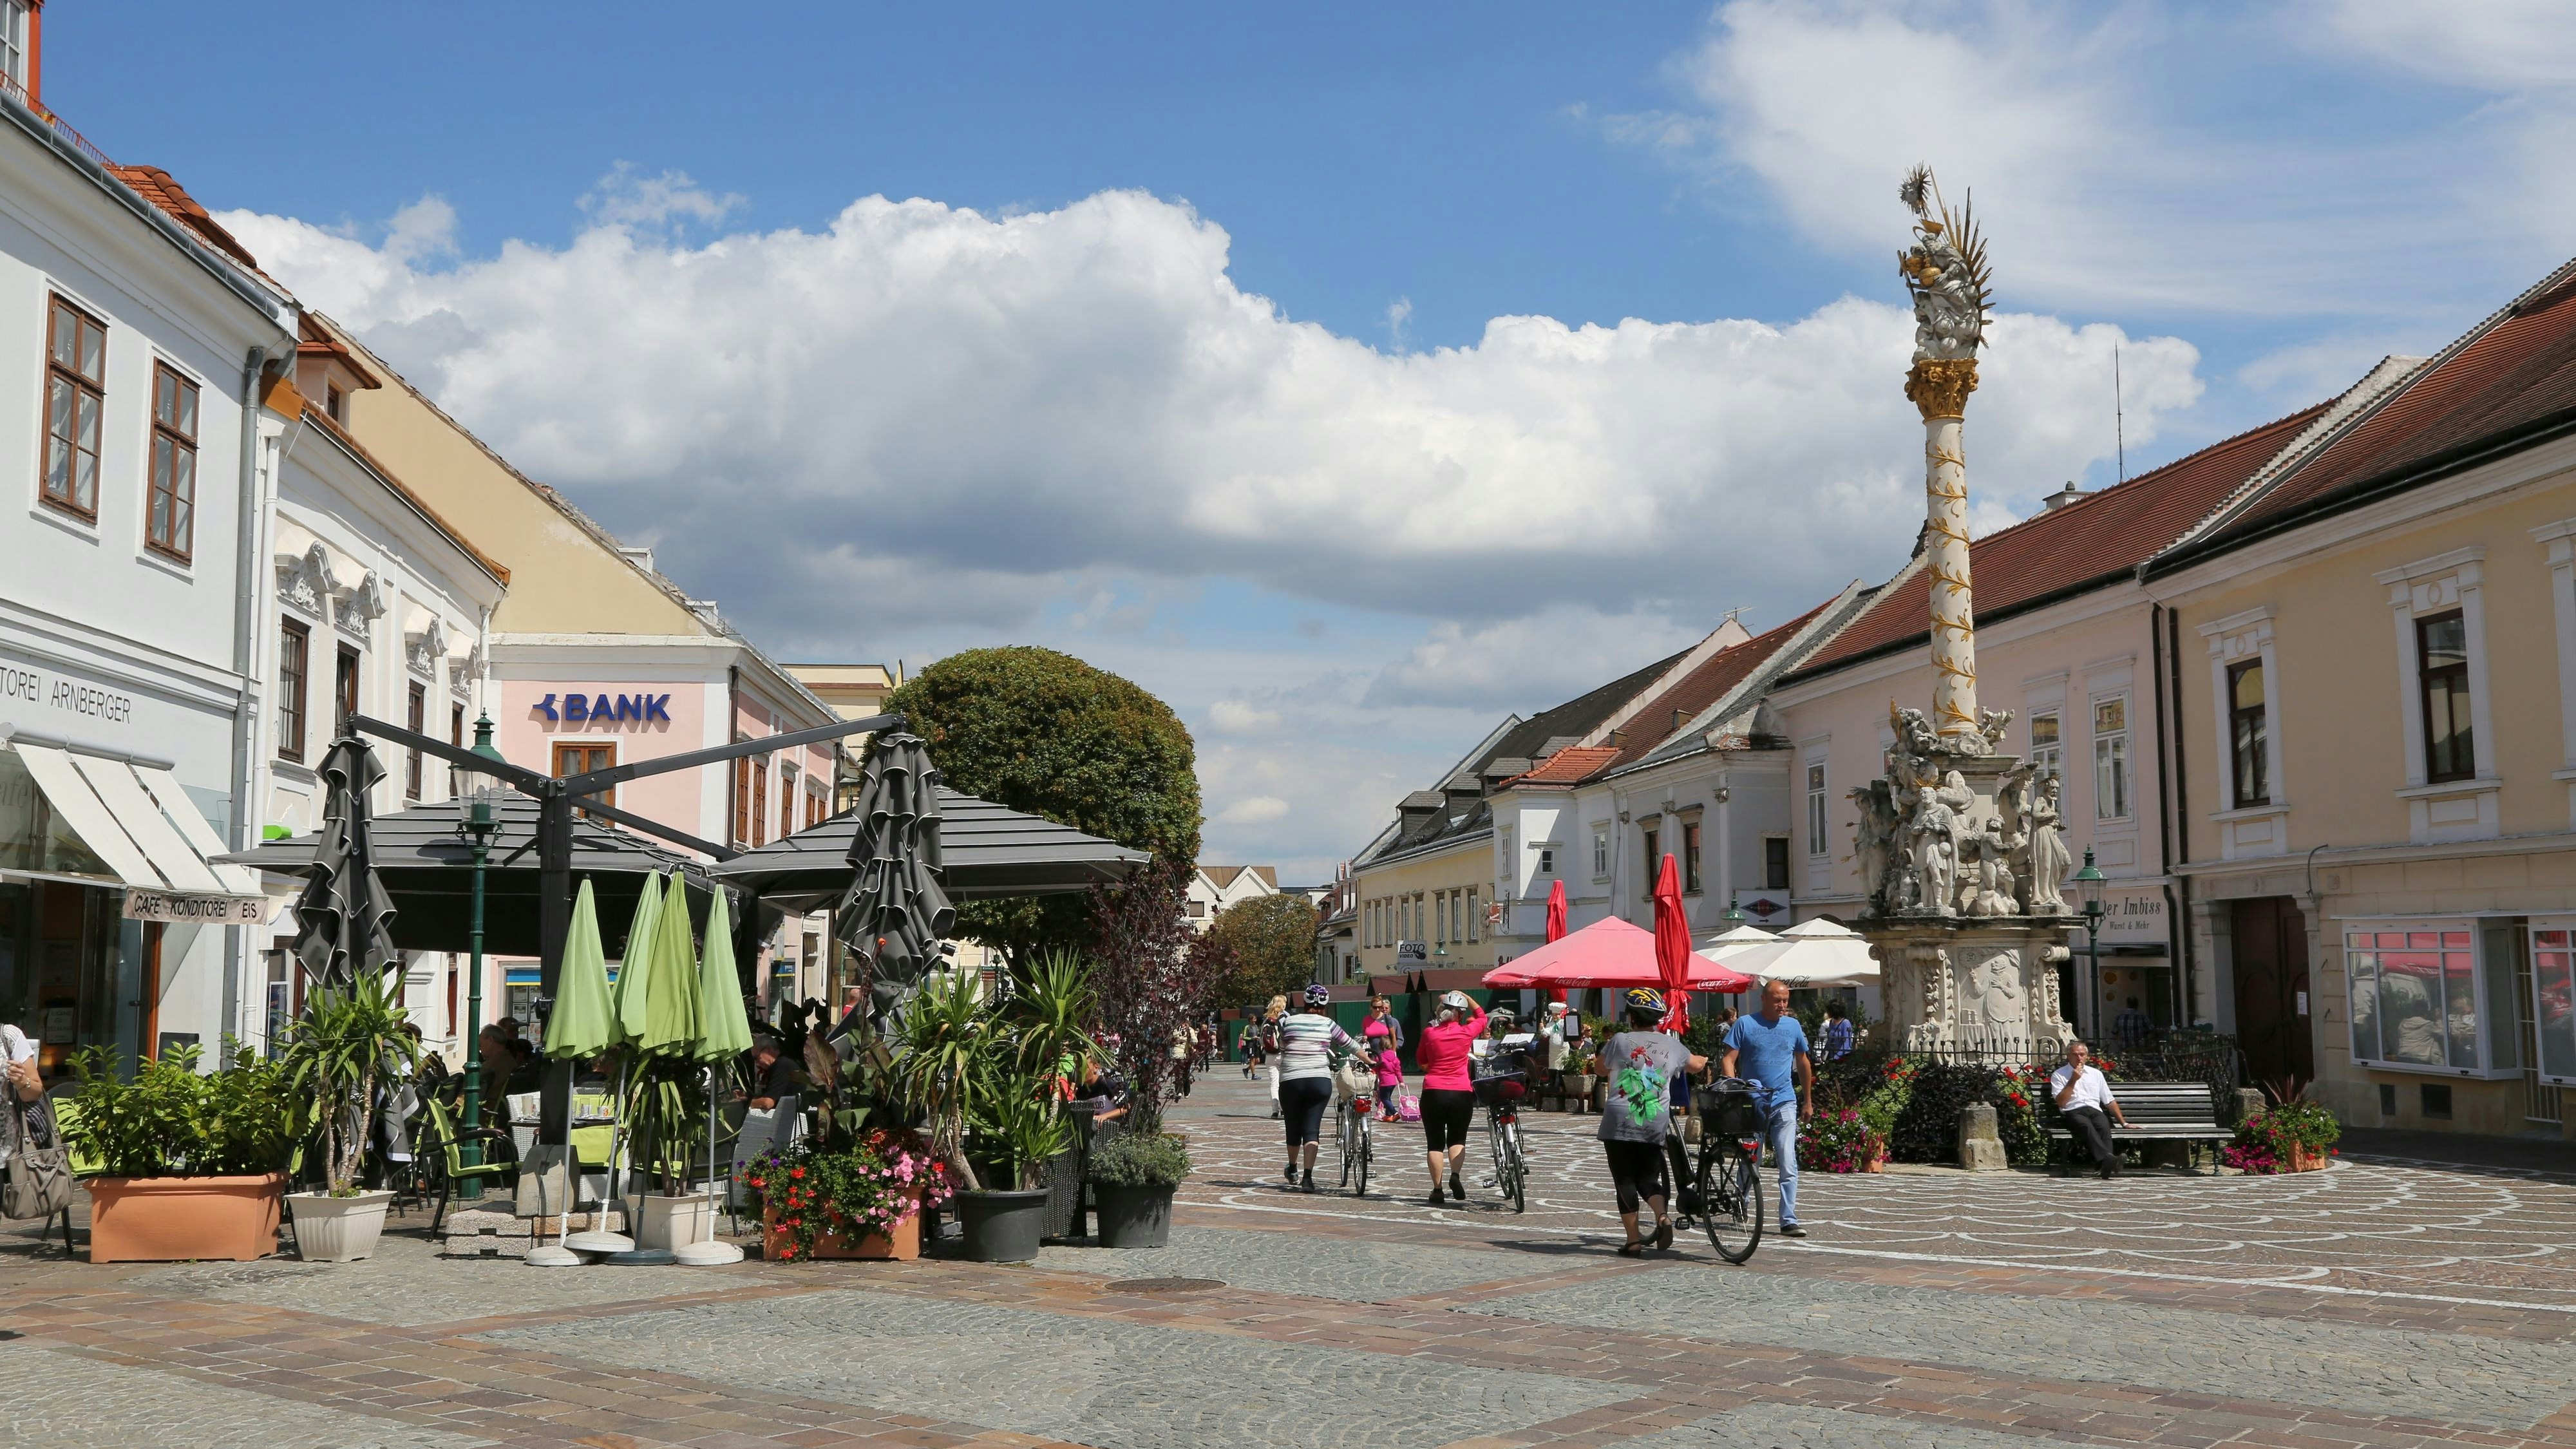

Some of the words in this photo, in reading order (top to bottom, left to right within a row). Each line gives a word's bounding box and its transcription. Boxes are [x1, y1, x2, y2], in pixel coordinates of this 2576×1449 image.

[50, 680, 131, 724] ARNBERGER
[565, 694, 671, 721] BANK
[134, 895, 161, 914] CAFE
[170, 899, 227, 918] KONDITOREI
[242, 902, 257, 918] EIS
[2123, 896, 2161, 915] Imbiss
[2109, 921, 2125, 930] Wurst
[2128, 922, 2132, 930] &
[2135, 920, 2150, 930] Mehr
[1399, 943, 1425, 952] FOTO
